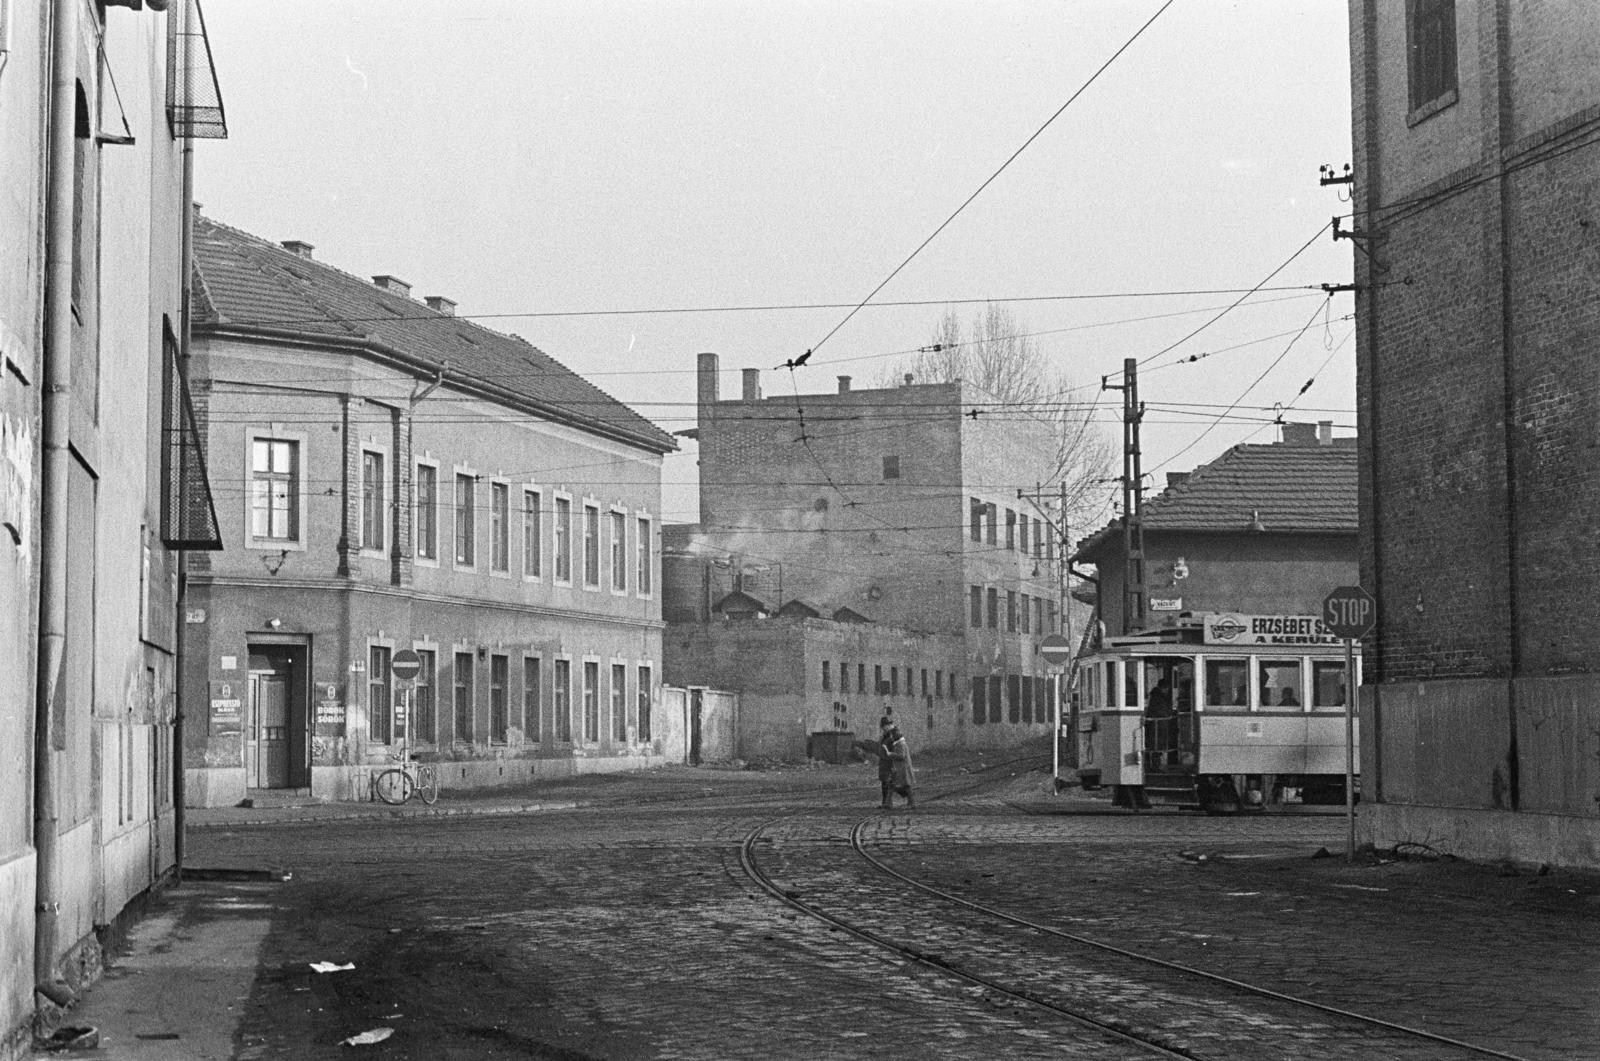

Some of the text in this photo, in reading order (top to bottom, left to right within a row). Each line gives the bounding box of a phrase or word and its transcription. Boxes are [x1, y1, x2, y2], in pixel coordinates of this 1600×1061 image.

[1328, 598, 1369, 626] STOP
[1252, 615, 1312, 634] ERZSÉBET
[1271, 635, 1349, 644] KERÜLE
[318, 706, 345, 714] BOROK
